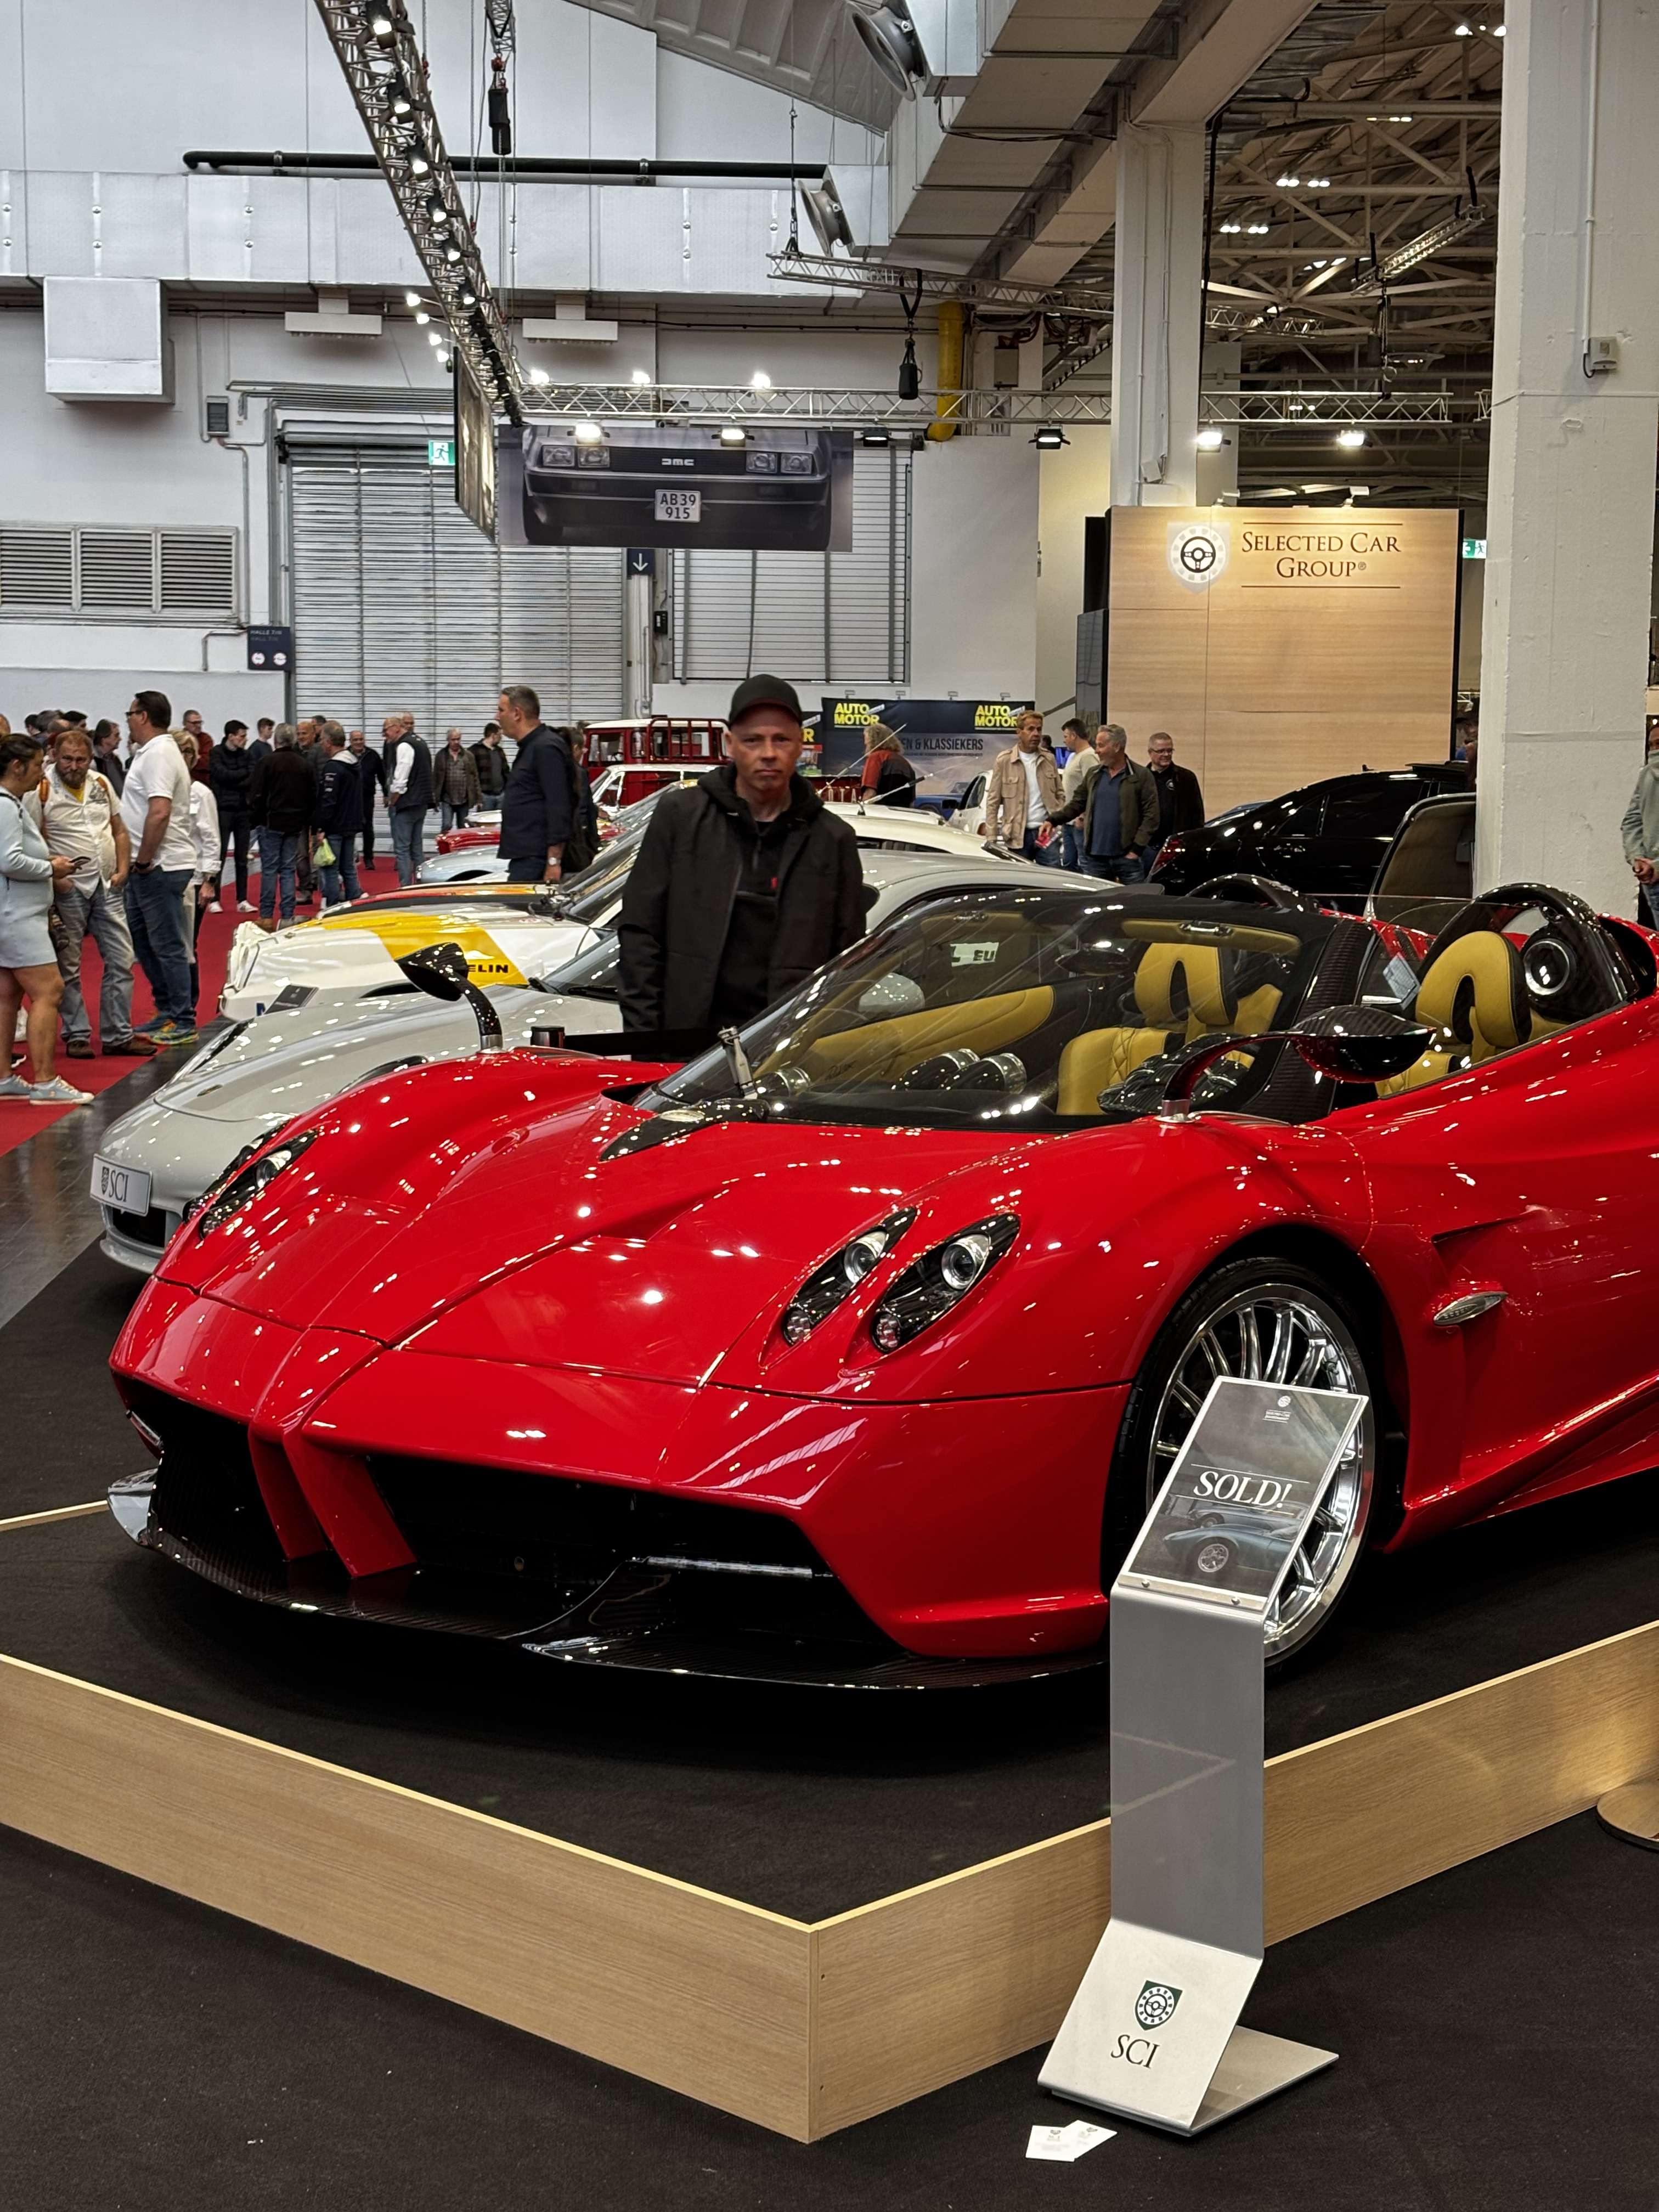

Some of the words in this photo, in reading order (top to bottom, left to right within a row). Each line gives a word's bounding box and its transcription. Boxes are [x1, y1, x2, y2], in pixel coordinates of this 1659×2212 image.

[660, 493, 696, 506] AB39
[665, 506, 690, 519] 915
[1242, 531, 1344, 552] SELECTED
[1350, 532, 1402, 554] CAR
[834, 703, 870, 714] AUTO
[975, 705, 1011, 716] AUTO
[834, 714, 880, 725] MOTOR
[915, 738, 921, 750] &
[923, 738, 984, 751] KLASSIEKERS
[467, 964, 509, 973] ELIN
[109, 1170, 129, 1202] SCI
[1193, 1471, 1293, 1508] SOLD!
[1110, 2034, 1160, 2069] SCI
